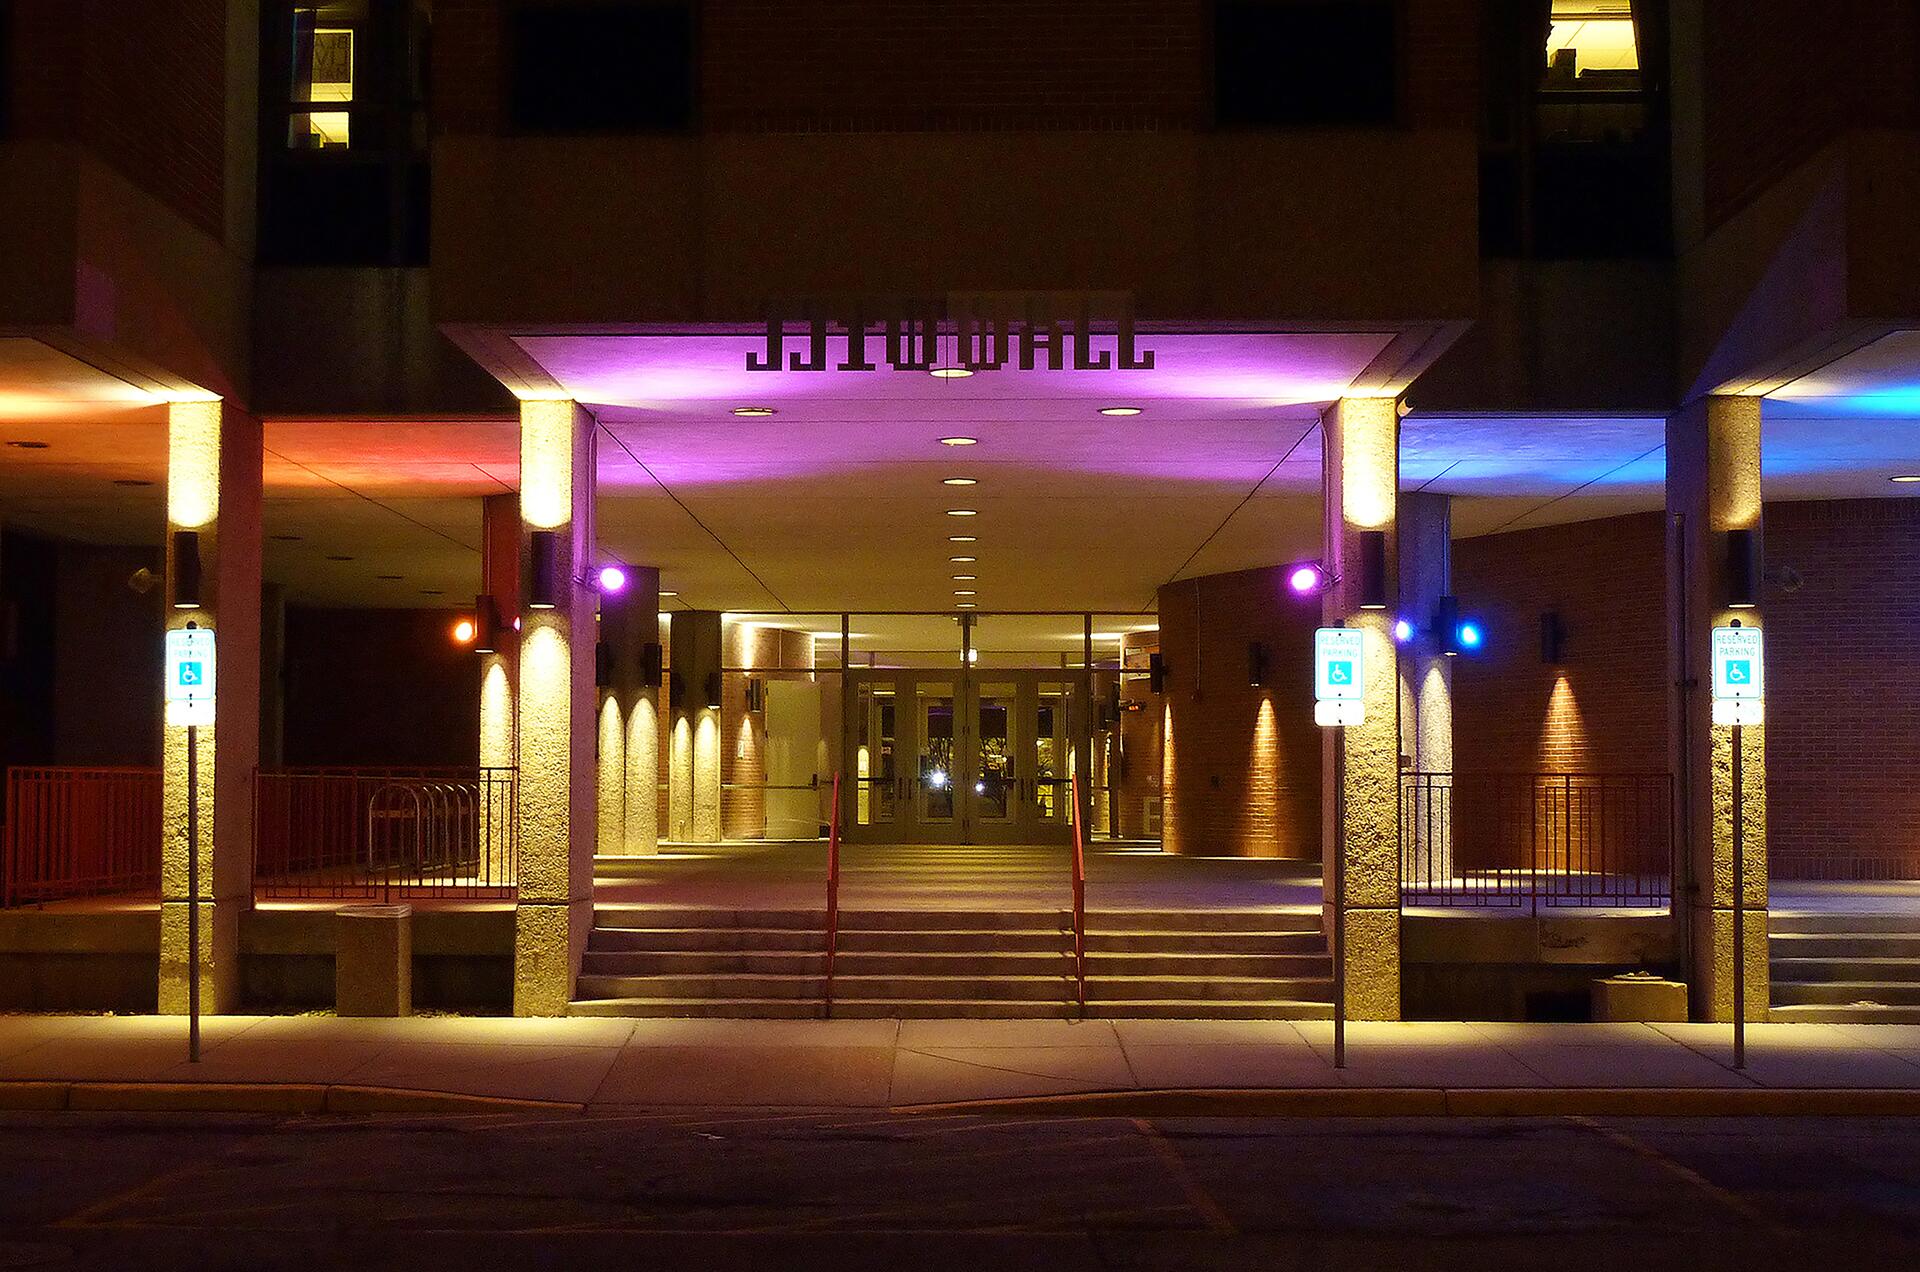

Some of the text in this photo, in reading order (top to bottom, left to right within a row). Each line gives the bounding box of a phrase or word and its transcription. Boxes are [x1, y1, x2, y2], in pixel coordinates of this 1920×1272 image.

[1321, 635, 1360, 646] RESERVED
[1716, 634, 1758, 645] RESERVED
[1322, 648, 1358, 658] PARKING
[1719, 646, 1756, 657] PARKING
